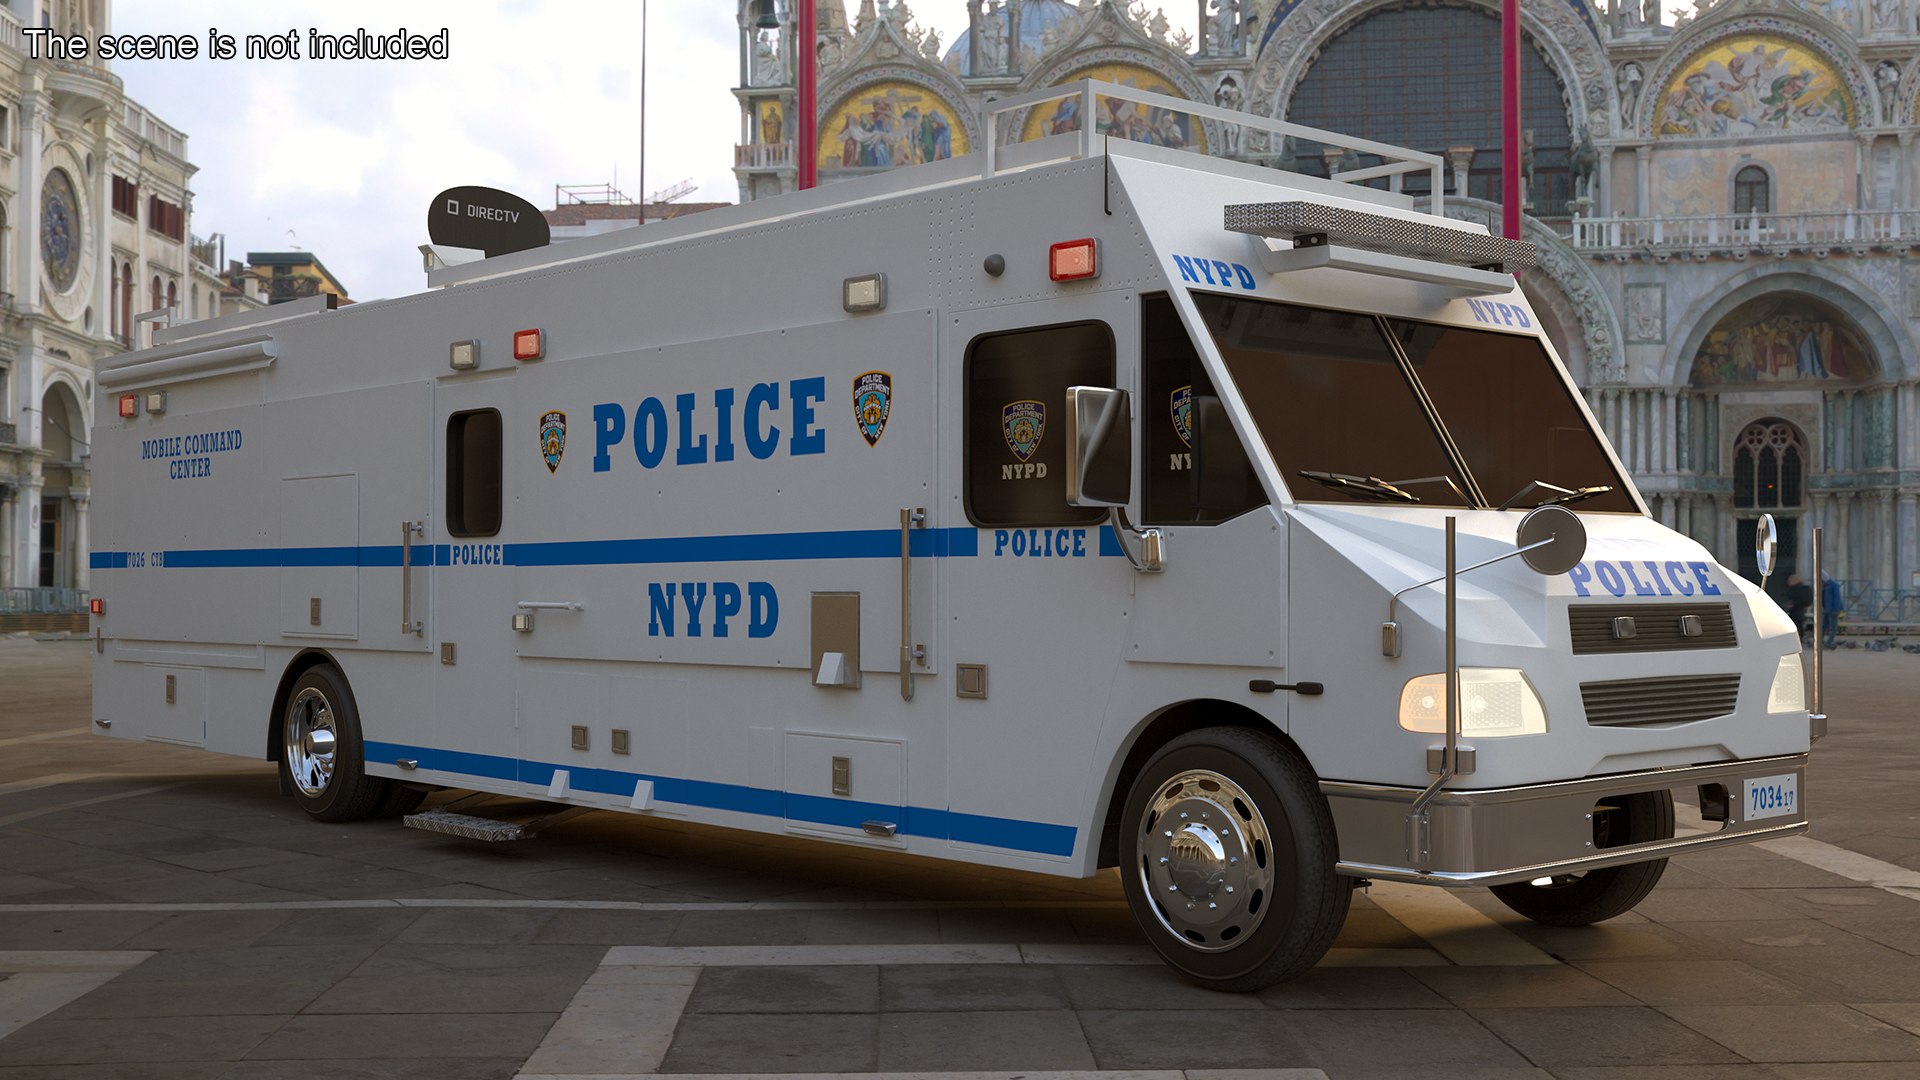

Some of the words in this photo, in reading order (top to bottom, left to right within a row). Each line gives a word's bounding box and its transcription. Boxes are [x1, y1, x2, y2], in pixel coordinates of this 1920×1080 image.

[467, 204, 520, 223] DIRECTV
[1172, 254, 1256, 290] NYPD
[1465, 298, 1531, 328] NYPD
[861, 374, 883, 384] POLICE
[855, 383, 890, 399] DEPARTMENT
[1005, 410, 1044, 423] DEPARTMENT
[1012, 403, 1035, 413] POLICE
[593, 376, 825, 473] POLICE
[142, 437, 181, 459] MOBILE
[184, 429, 243, 455] COMMAND
[170, 457, 211, 480] CENTER
[1002, 462, 1047, 480] NYPD
[1170, 453, 1192, 471] NY
[995, 528, 1086, 557] POLICE
[128, 551, 145, 568] 7026
[452, 543, 500, 565] POLICE
[1568, 560, 1721, 597] POLICE
[648, 581, 779, 638] NYPD
[1751, 784, 1783, 811] 7034
[1784, 790, 1794, 806] 17
